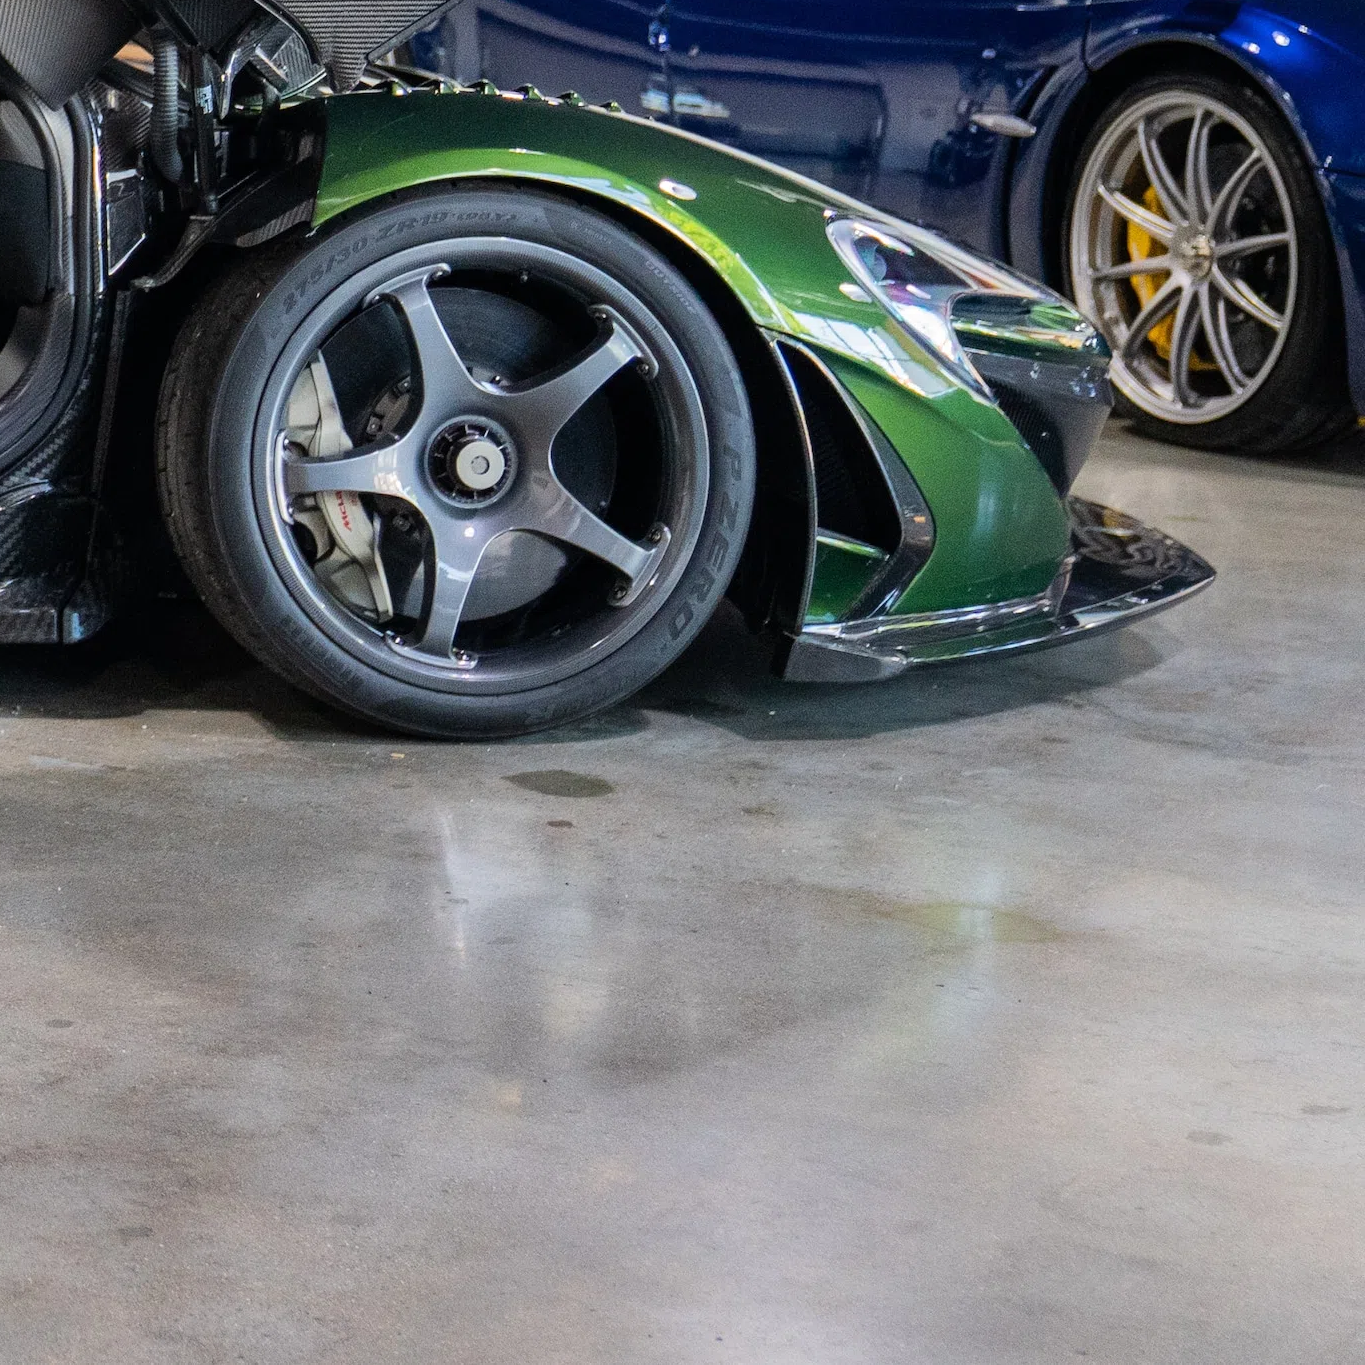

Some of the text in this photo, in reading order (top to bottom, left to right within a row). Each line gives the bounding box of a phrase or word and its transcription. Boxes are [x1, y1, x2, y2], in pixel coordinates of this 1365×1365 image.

[282, 238, 368, 315] 275/30
[671, 443, 743, 641] P ZERO
